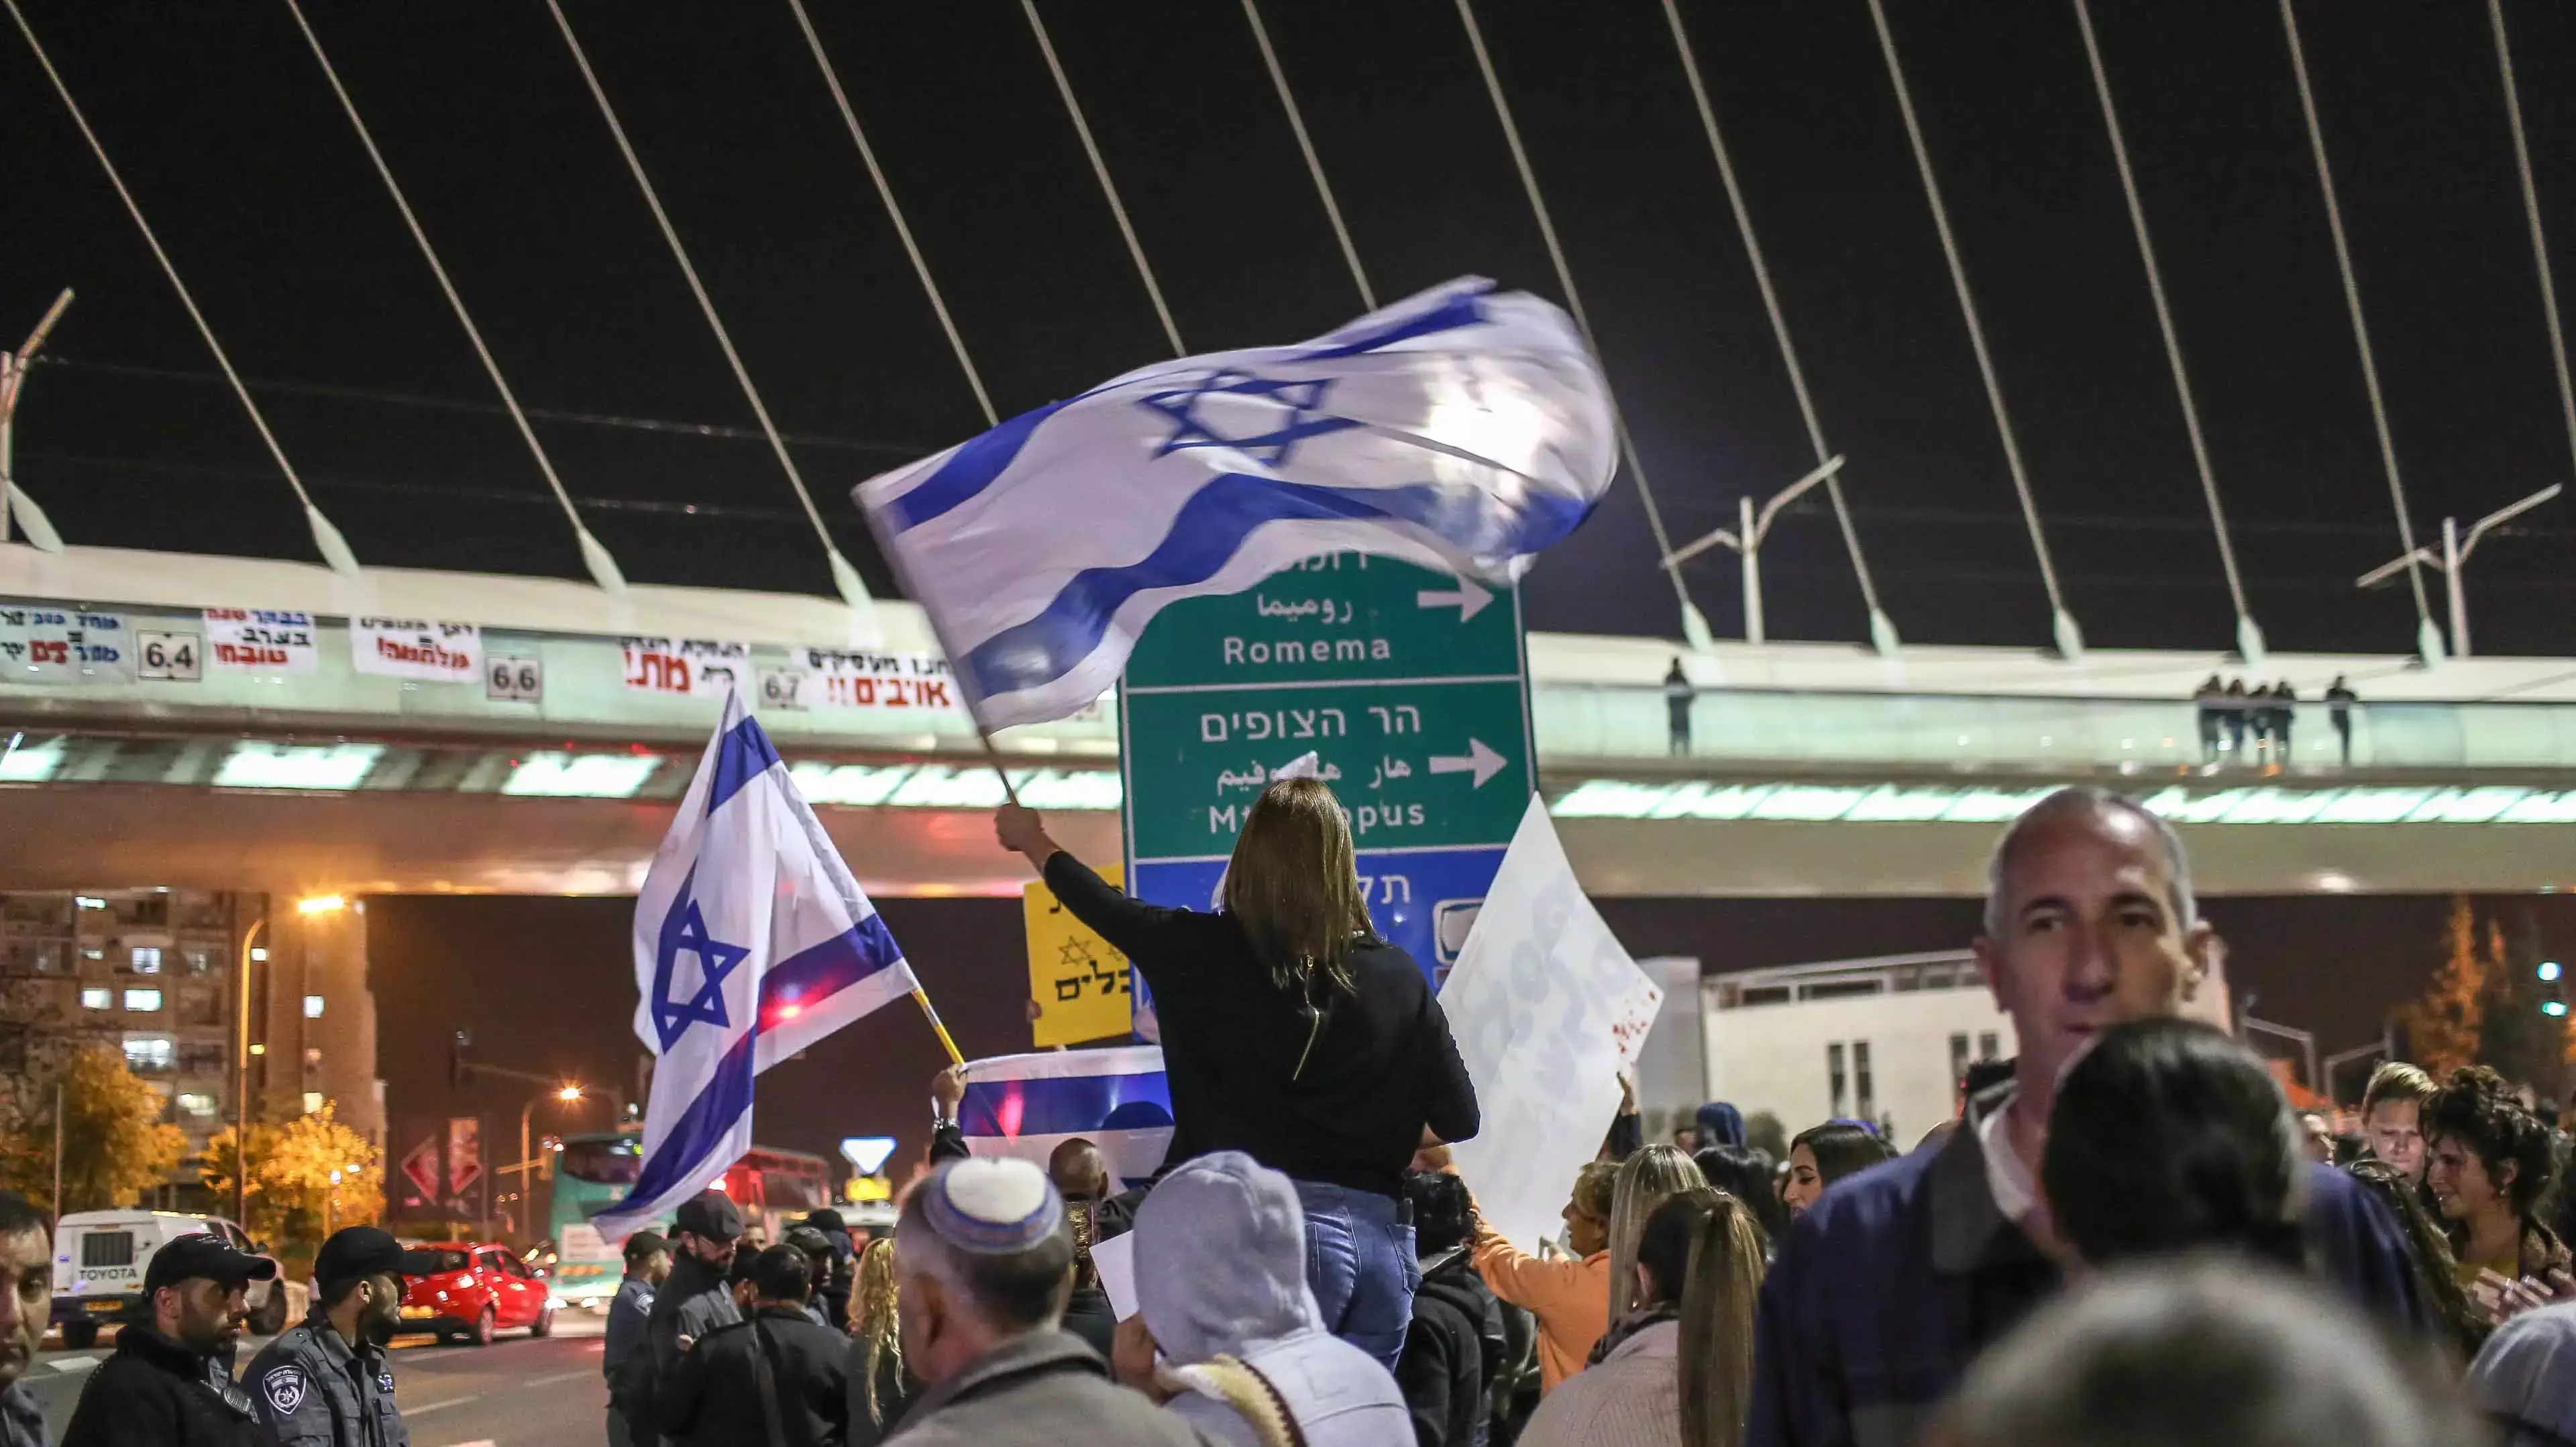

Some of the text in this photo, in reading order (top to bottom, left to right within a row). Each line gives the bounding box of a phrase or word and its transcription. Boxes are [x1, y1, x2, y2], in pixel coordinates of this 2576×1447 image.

[1257, 593, 1353, 624] روميما
[30, 640, 70, 663] דם
[146, 642, 193, 669] 6.4
[1224, 637, 1390, 664] Romema
[1201, 706, 1421, 742] הר הצופים
[79, 1268, 137, 1281] TOYOTA
